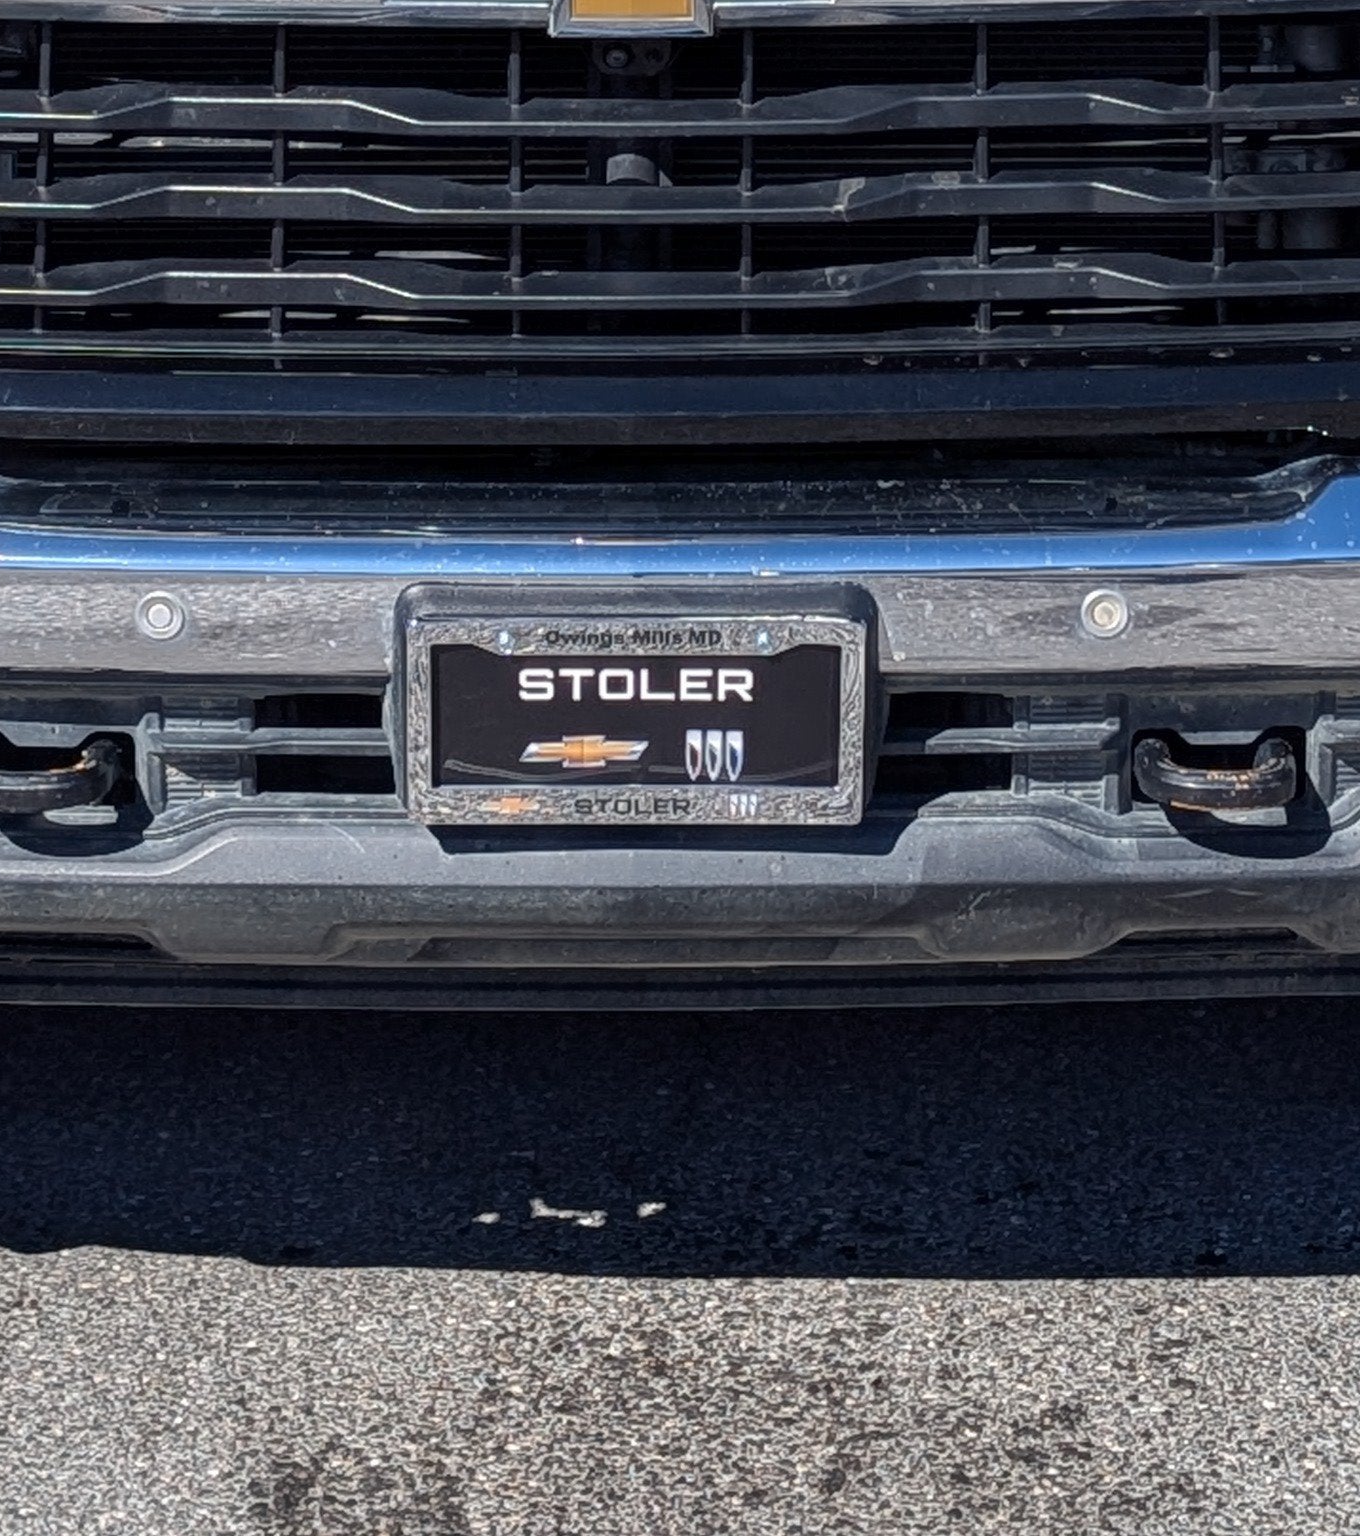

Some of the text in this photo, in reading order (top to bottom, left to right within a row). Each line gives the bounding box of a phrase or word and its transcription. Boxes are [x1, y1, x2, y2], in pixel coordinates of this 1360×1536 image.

[545, 630, 626, 648] Owings
[689, 629, 722, 646] MD
[518, 668, 754, 702] STOLER
[573, 797, 691, 815] STOLER
